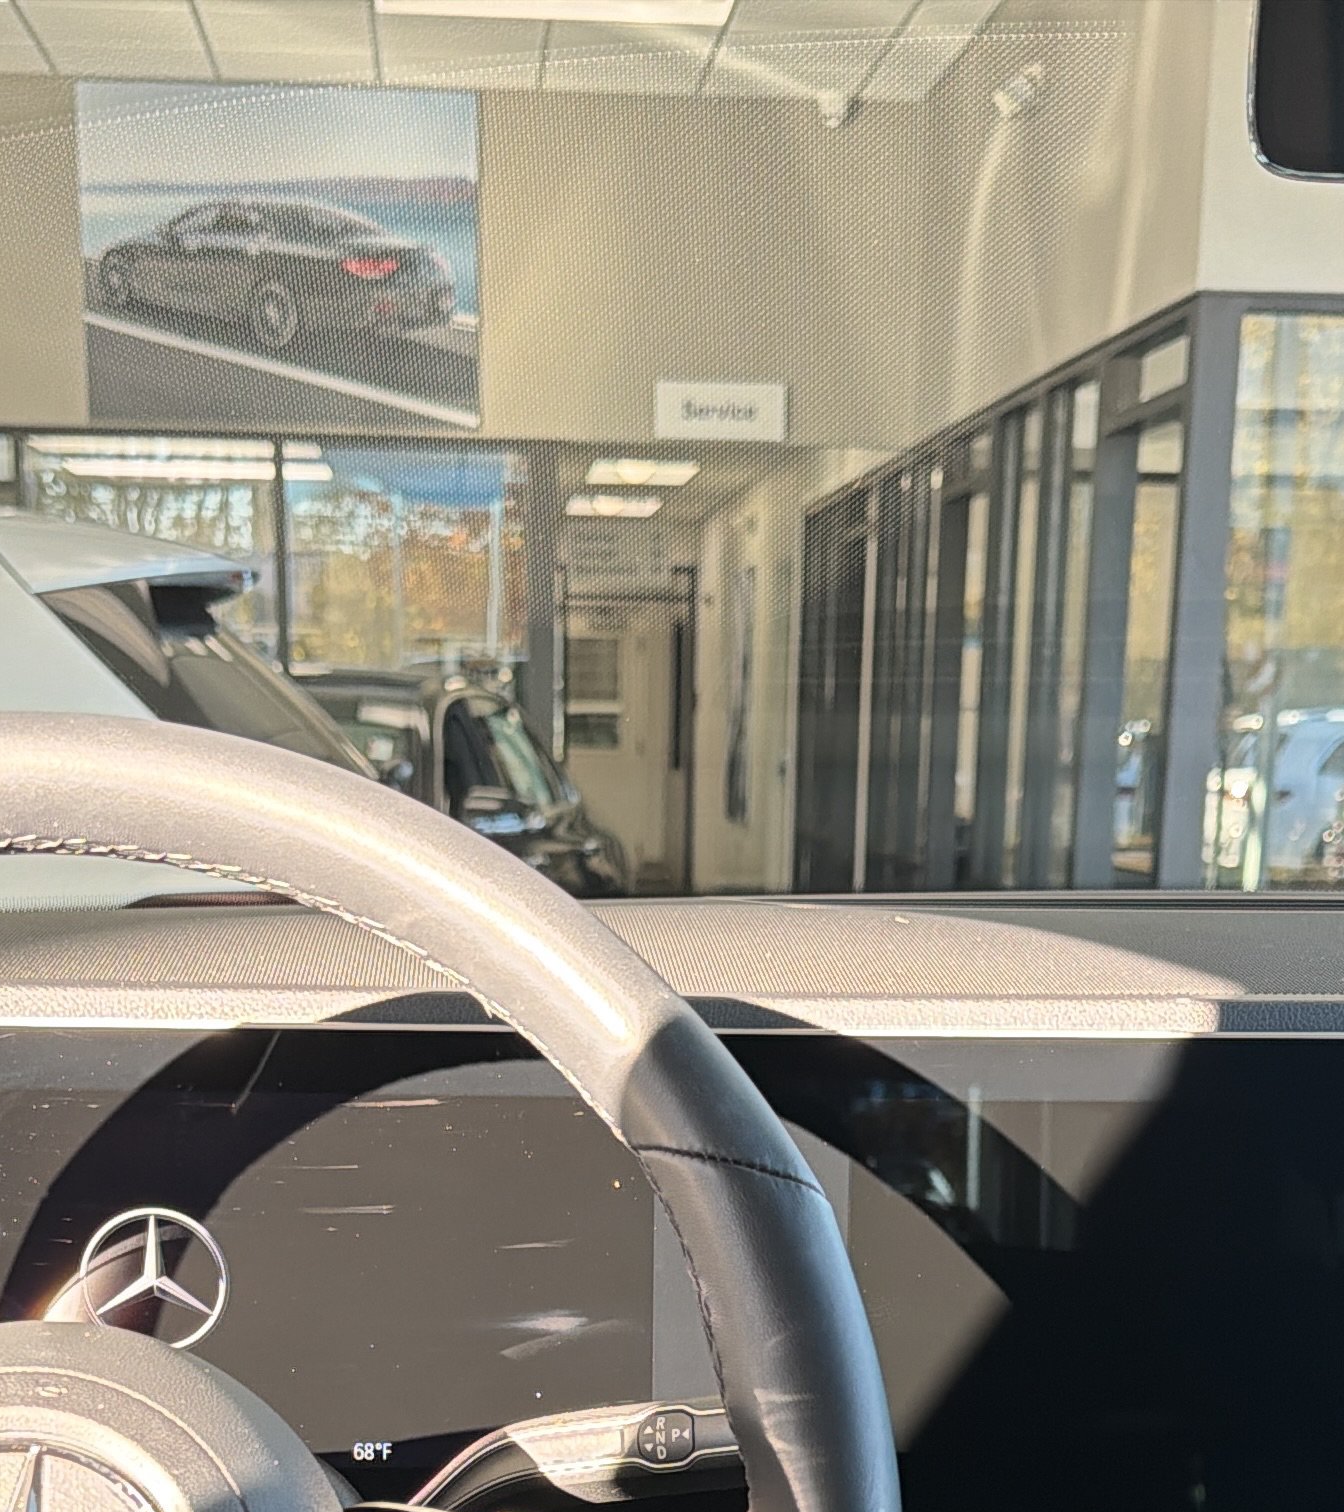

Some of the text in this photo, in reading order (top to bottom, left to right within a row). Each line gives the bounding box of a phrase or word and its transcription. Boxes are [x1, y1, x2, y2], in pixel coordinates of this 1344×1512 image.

[682, 401, 758, 421] Service
[656, 1416, 667, 1460] R N D
[671, 1428, 681, 1443] P
[353, 1442, 393, 1461] 68°F
